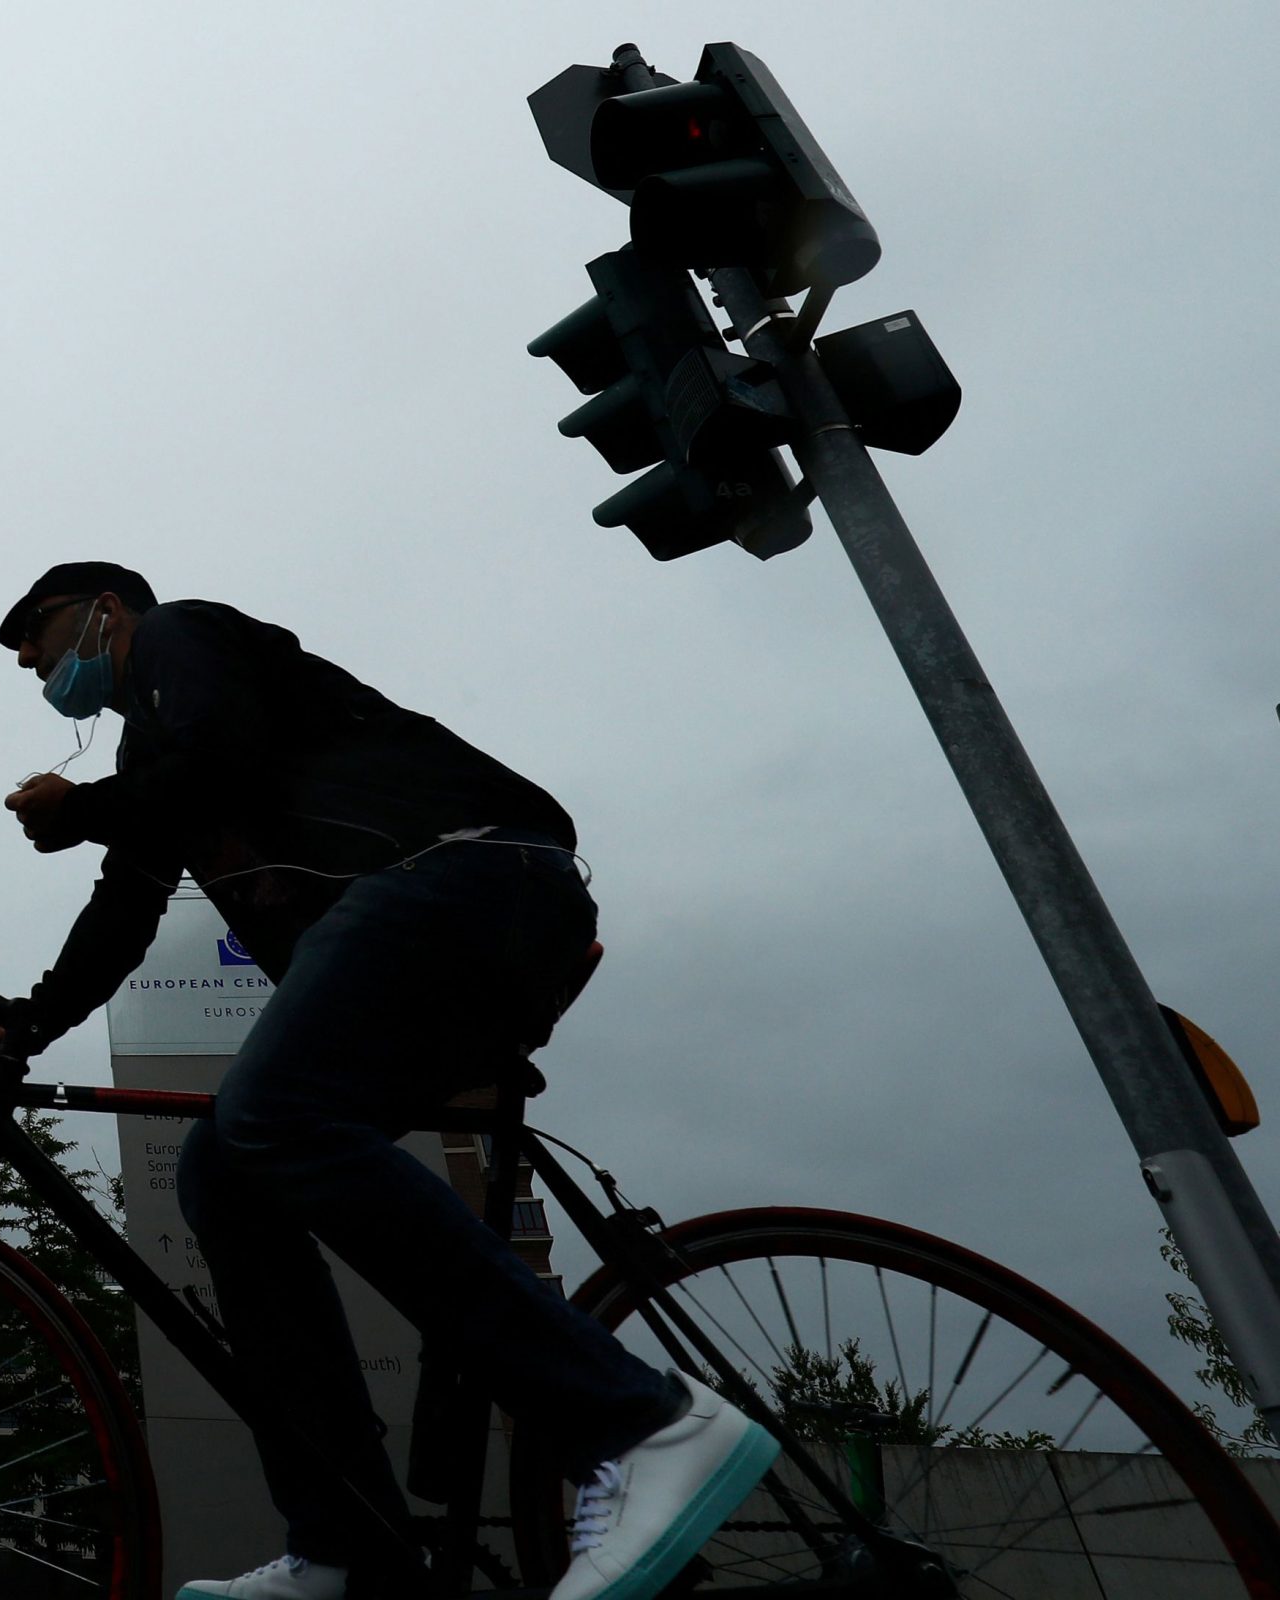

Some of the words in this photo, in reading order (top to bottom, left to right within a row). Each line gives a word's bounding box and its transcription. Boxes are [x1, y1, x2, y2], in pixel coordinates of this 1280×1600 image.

[130, 979, 224, 990] EUROPEAN
[234, 978, 268, 988] CEN
[150, 1177, 176, 1190] 603
